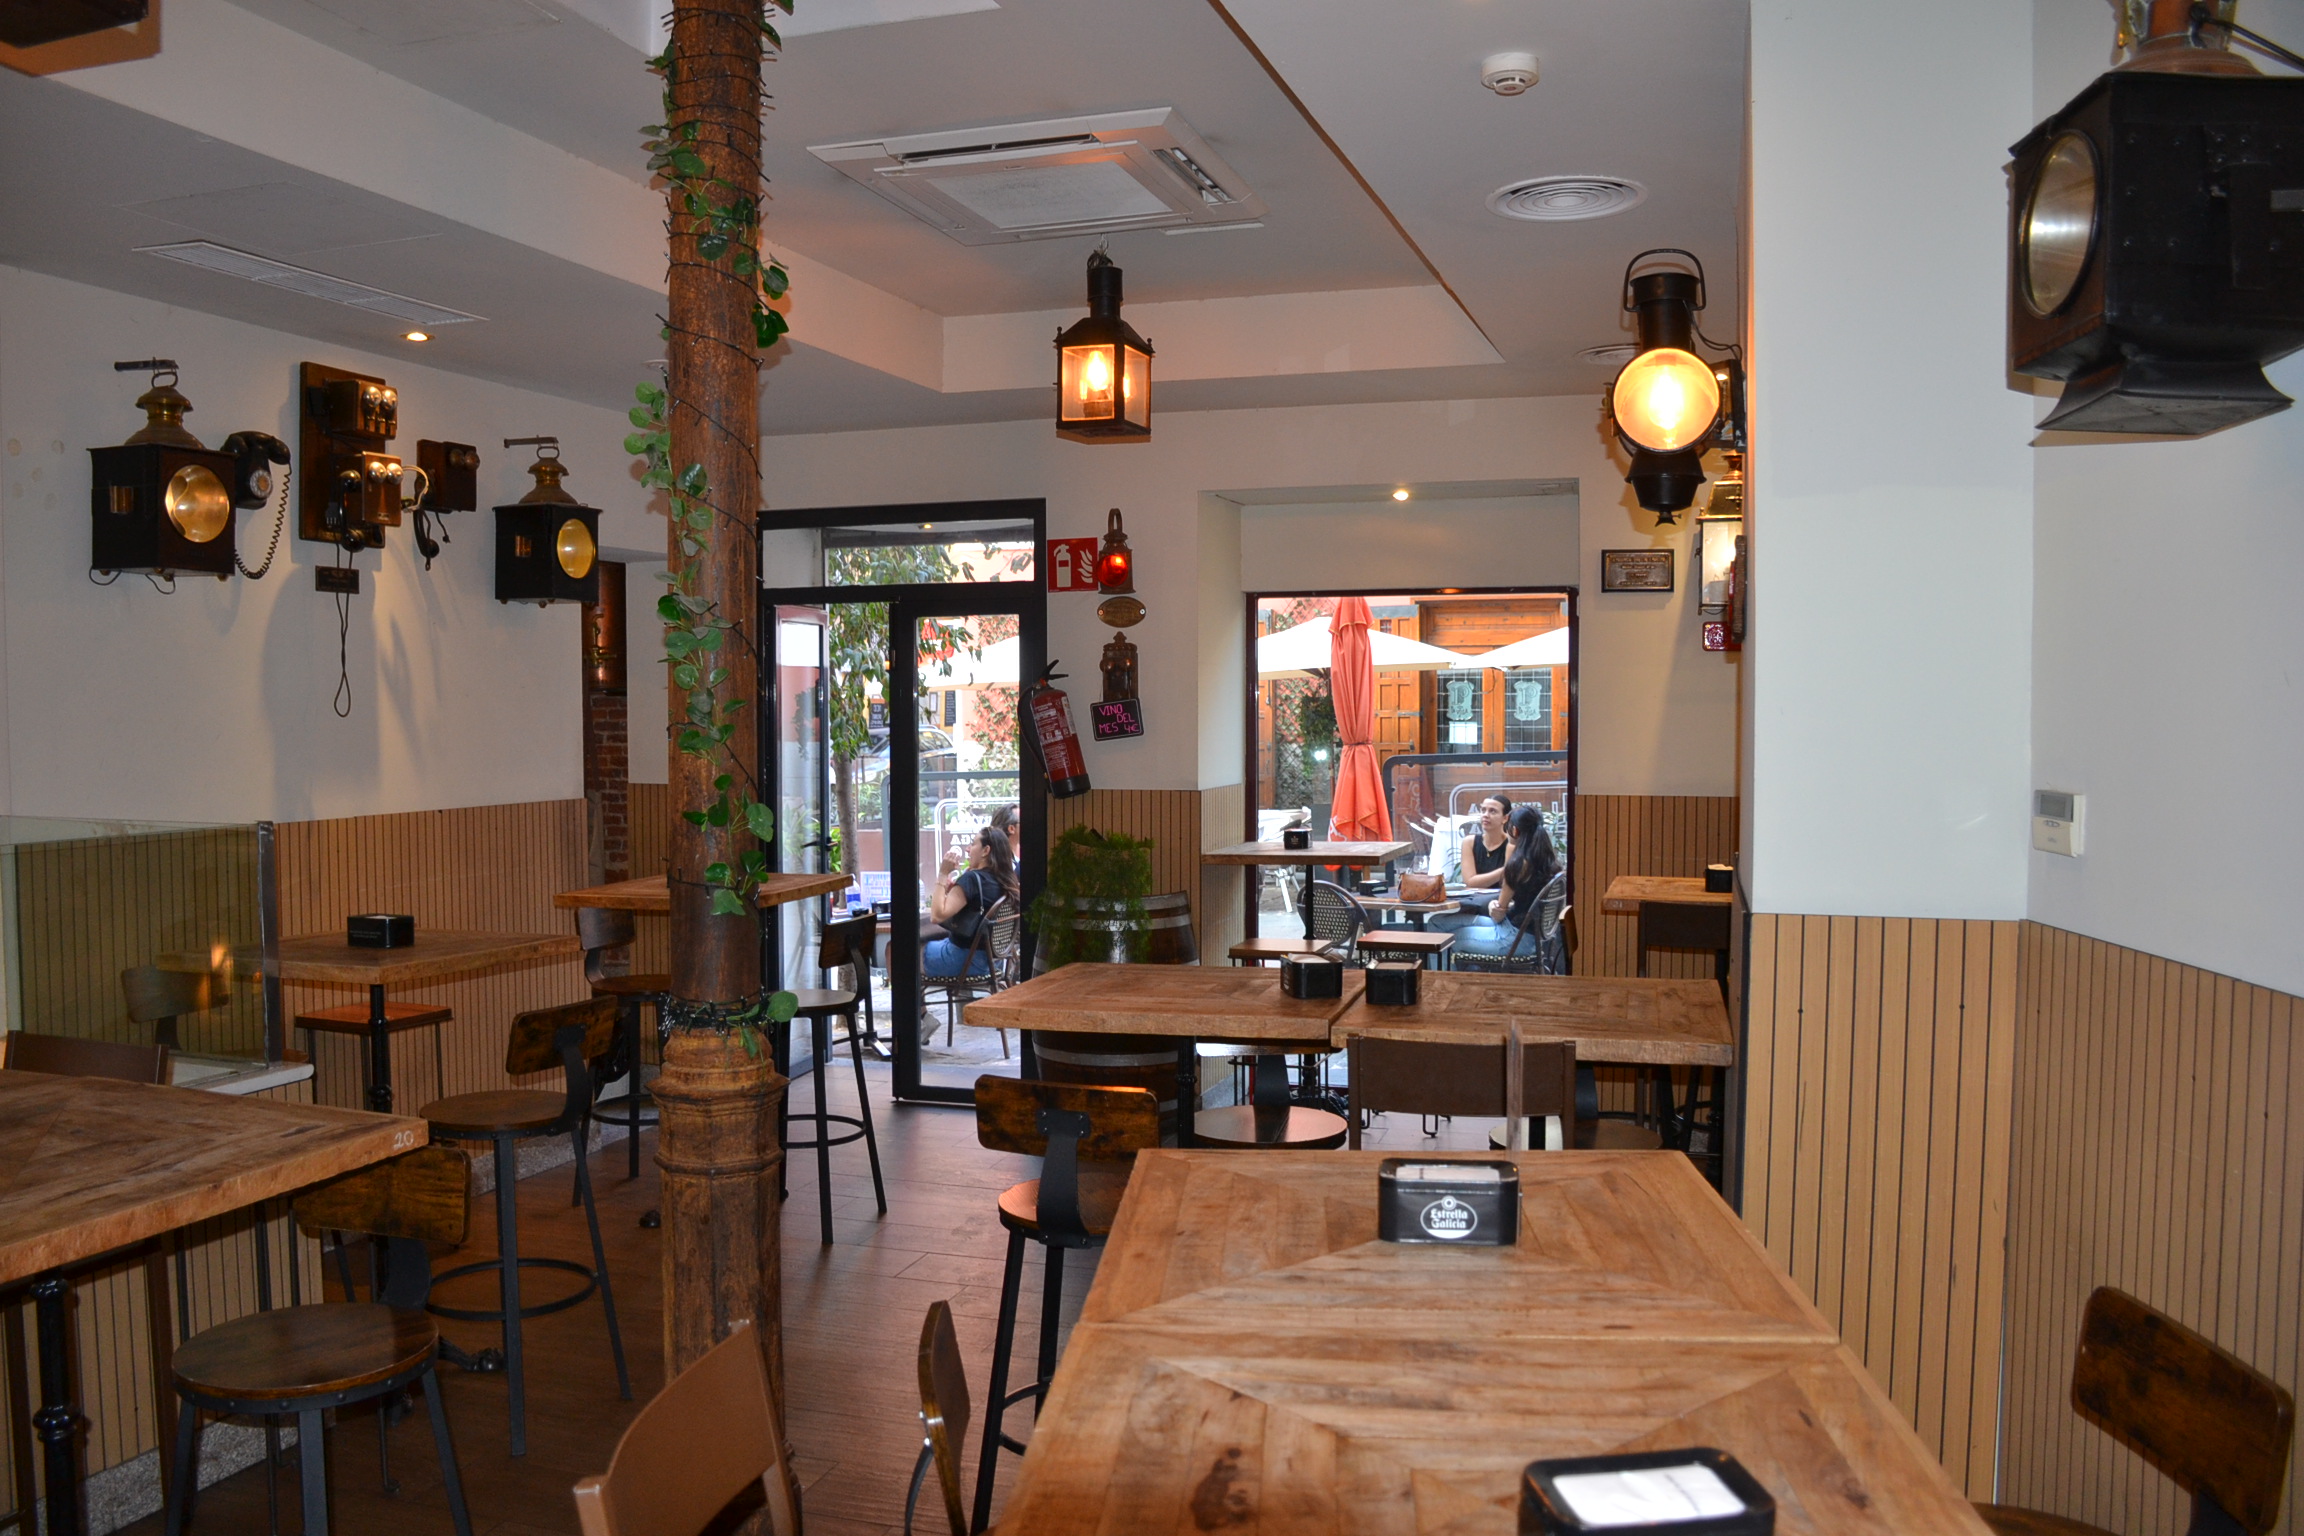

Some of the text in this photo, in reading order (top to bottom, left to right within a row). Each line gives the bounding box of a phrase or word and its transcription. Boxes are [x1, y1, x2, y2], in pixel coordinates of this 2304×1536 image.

[1099, 704, 1123, 716] VINO
[1116, 713, 1135, 723] DEL
[1099, 722, 1140, 734] MES 4€
[393, 1130, 414, 1150] 20
[1430, 1207, 1469, 1219] Estrella
[1431, 1218, 1467, 1229] Galicia
